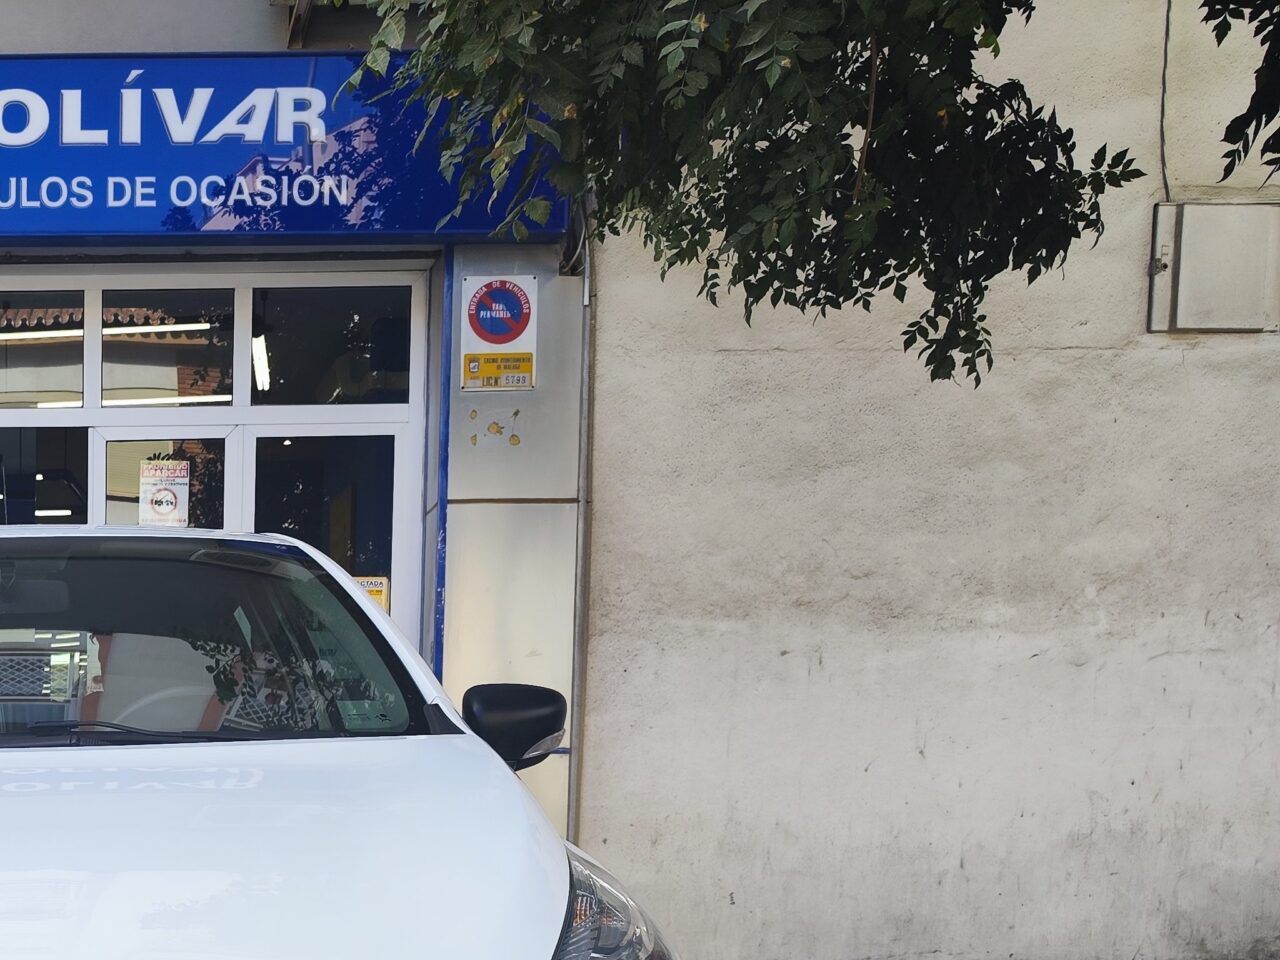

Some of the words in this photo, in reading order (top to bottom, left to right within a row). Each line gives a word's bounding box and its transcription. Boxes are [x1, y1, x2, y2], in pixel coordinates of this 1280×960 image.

[107, 176, 156, 208] DE
[170, 166, 347, 208] OCASIÓN
[469, 287, 487, 314] ENTRADA
[143, 469, 188, 477] APARCAR
